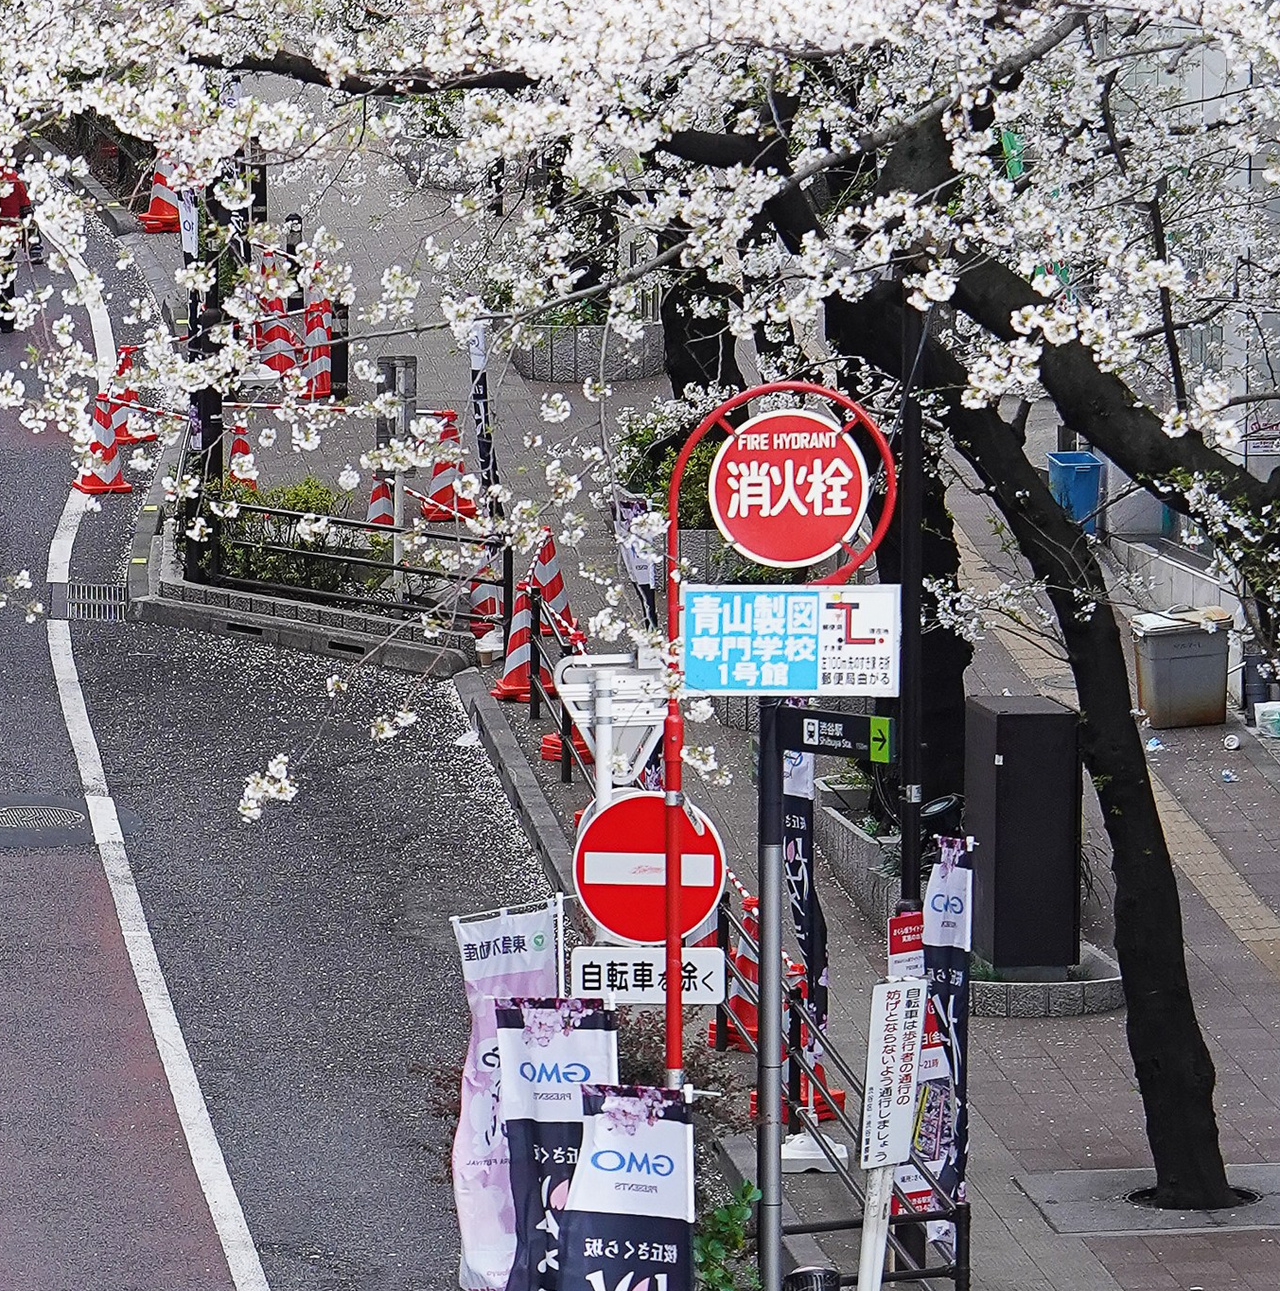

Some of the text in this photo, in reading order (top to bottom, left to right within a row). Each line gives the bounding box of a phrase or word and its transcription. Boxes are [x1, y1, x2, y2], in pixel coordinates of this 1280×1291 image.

[737, 431, 838, 451] FIRE HYDRANT
[726, 457, 854, 519] 消火栓
[691, 594, 818, 636] 青山製図
[690, 636, 817, 662] 専門学校
[718, 661, 789, 687] 1号館
[821, 672, 890, 685] 郵便局曲がる
